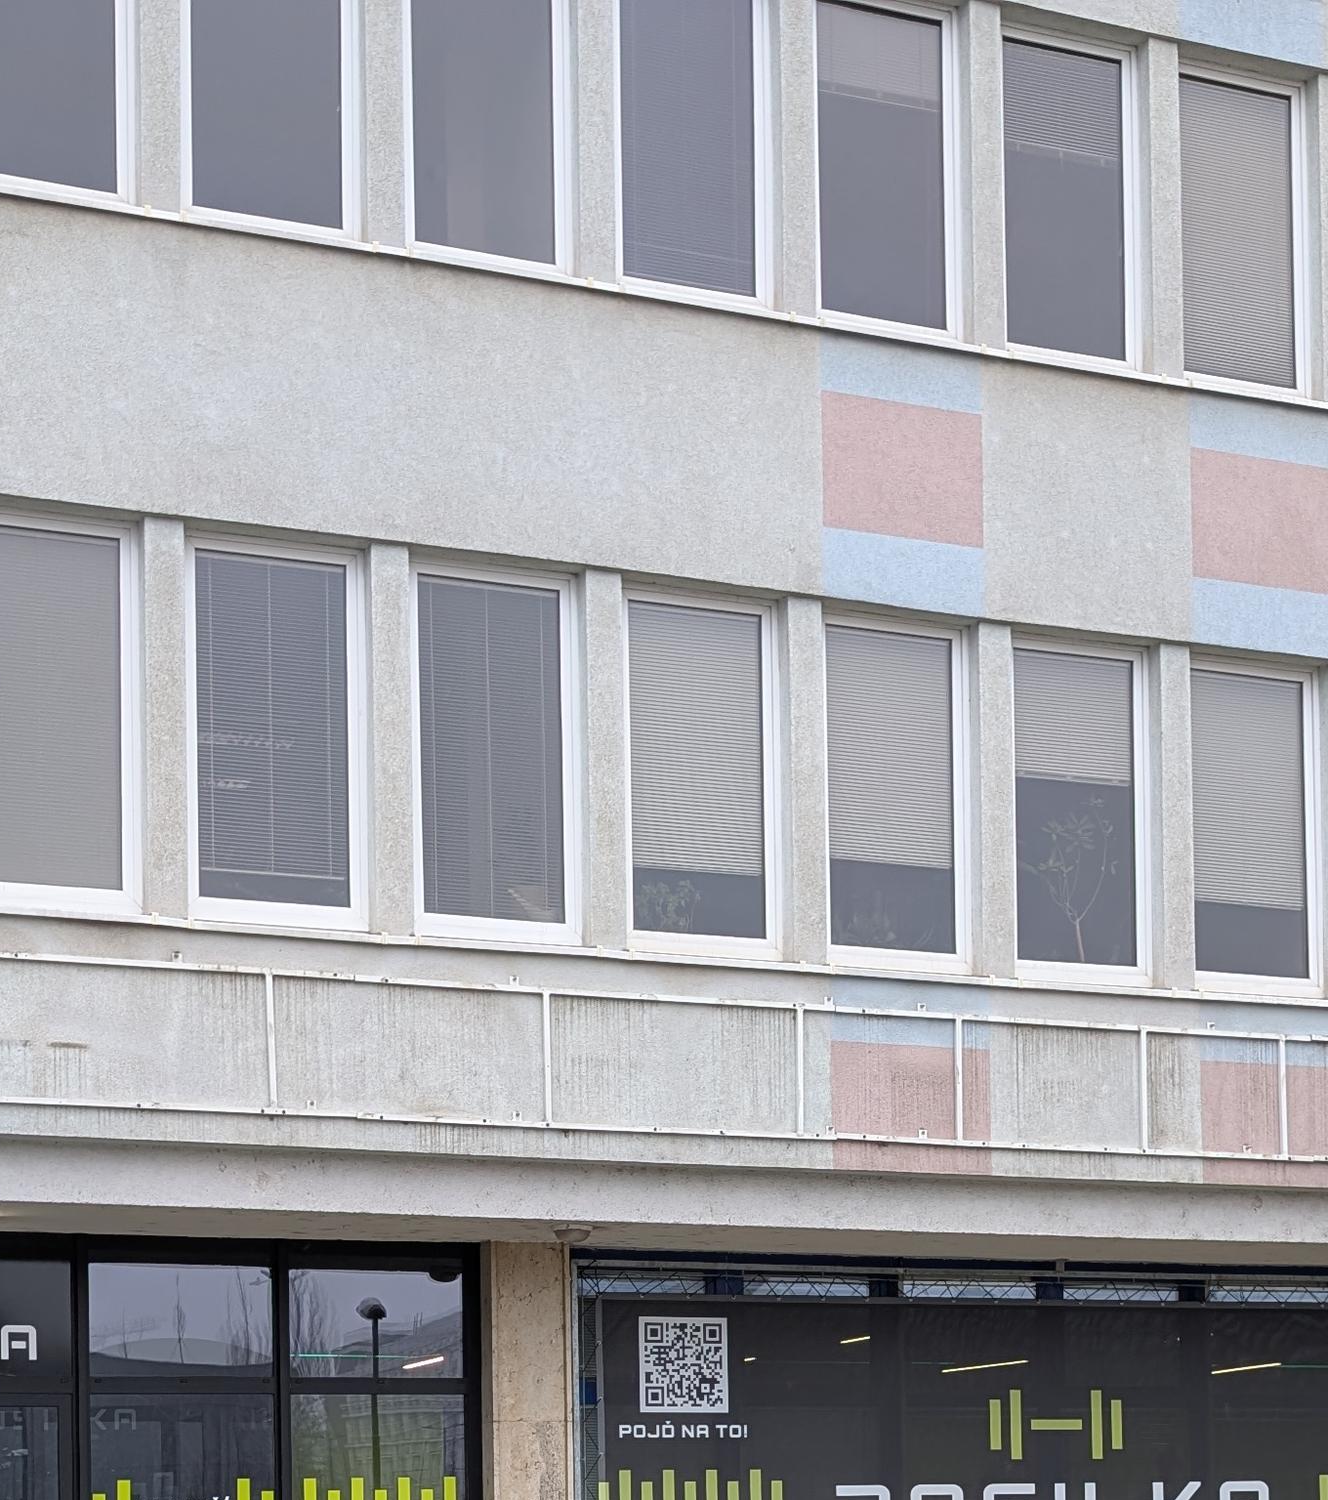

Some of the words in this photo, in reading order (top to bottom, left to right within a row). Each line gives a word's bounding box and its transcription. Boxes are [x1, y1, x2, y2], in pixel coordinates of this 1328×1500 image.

[618, 1420, 675, 1439] POJĎ
[681, 1424, 710, 1439] NA
[715, 1424, 749, 1439] TO!
